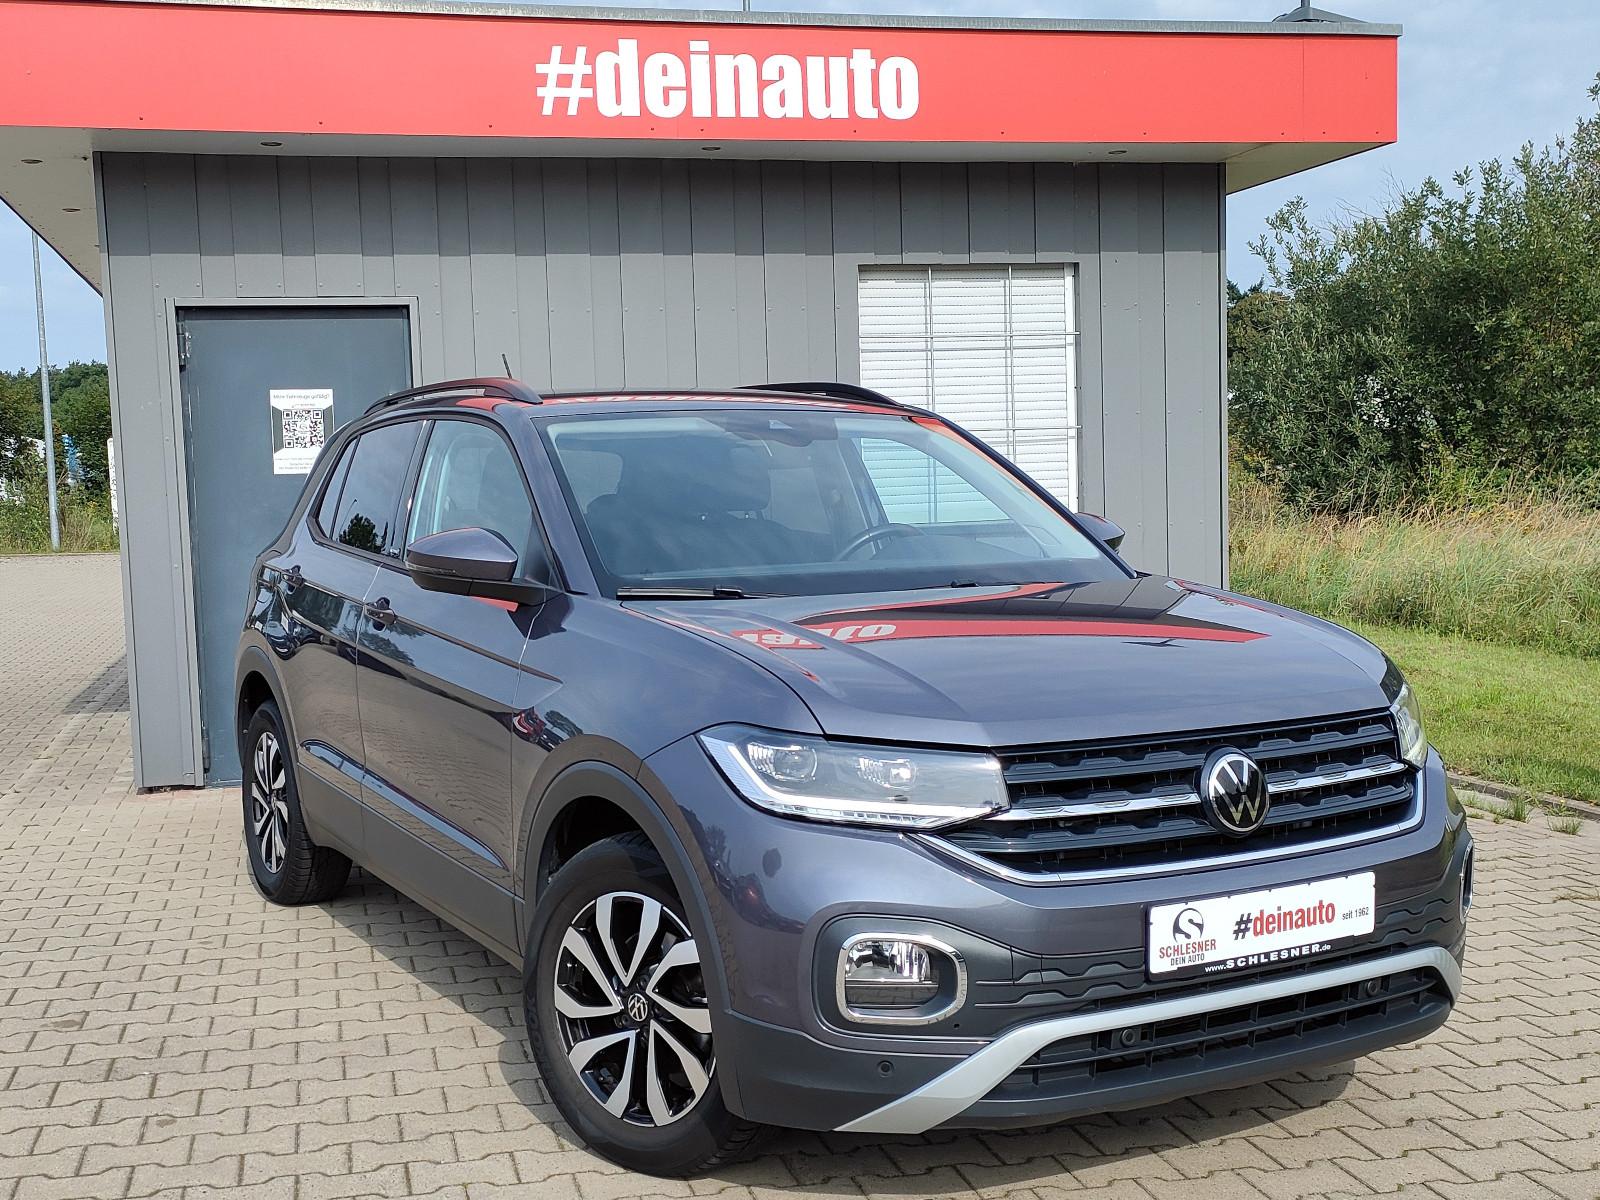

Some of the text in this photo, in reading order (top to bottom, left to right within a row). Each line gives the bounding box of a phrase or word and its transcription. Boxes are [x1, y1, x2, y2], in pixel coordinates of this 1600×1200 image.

[535, 38, 920, 120] #deinauto
[1233, 899, 1336, 941] #deinauto
[1341, 906, 1369, 921] seit 1962
[1159, 939, 1216, 959] SCHLESNER
[1170, 953, 1205, 967] DEIN AUTO
[1204, 943, 1332, 973] www.SCHLESNER.de
